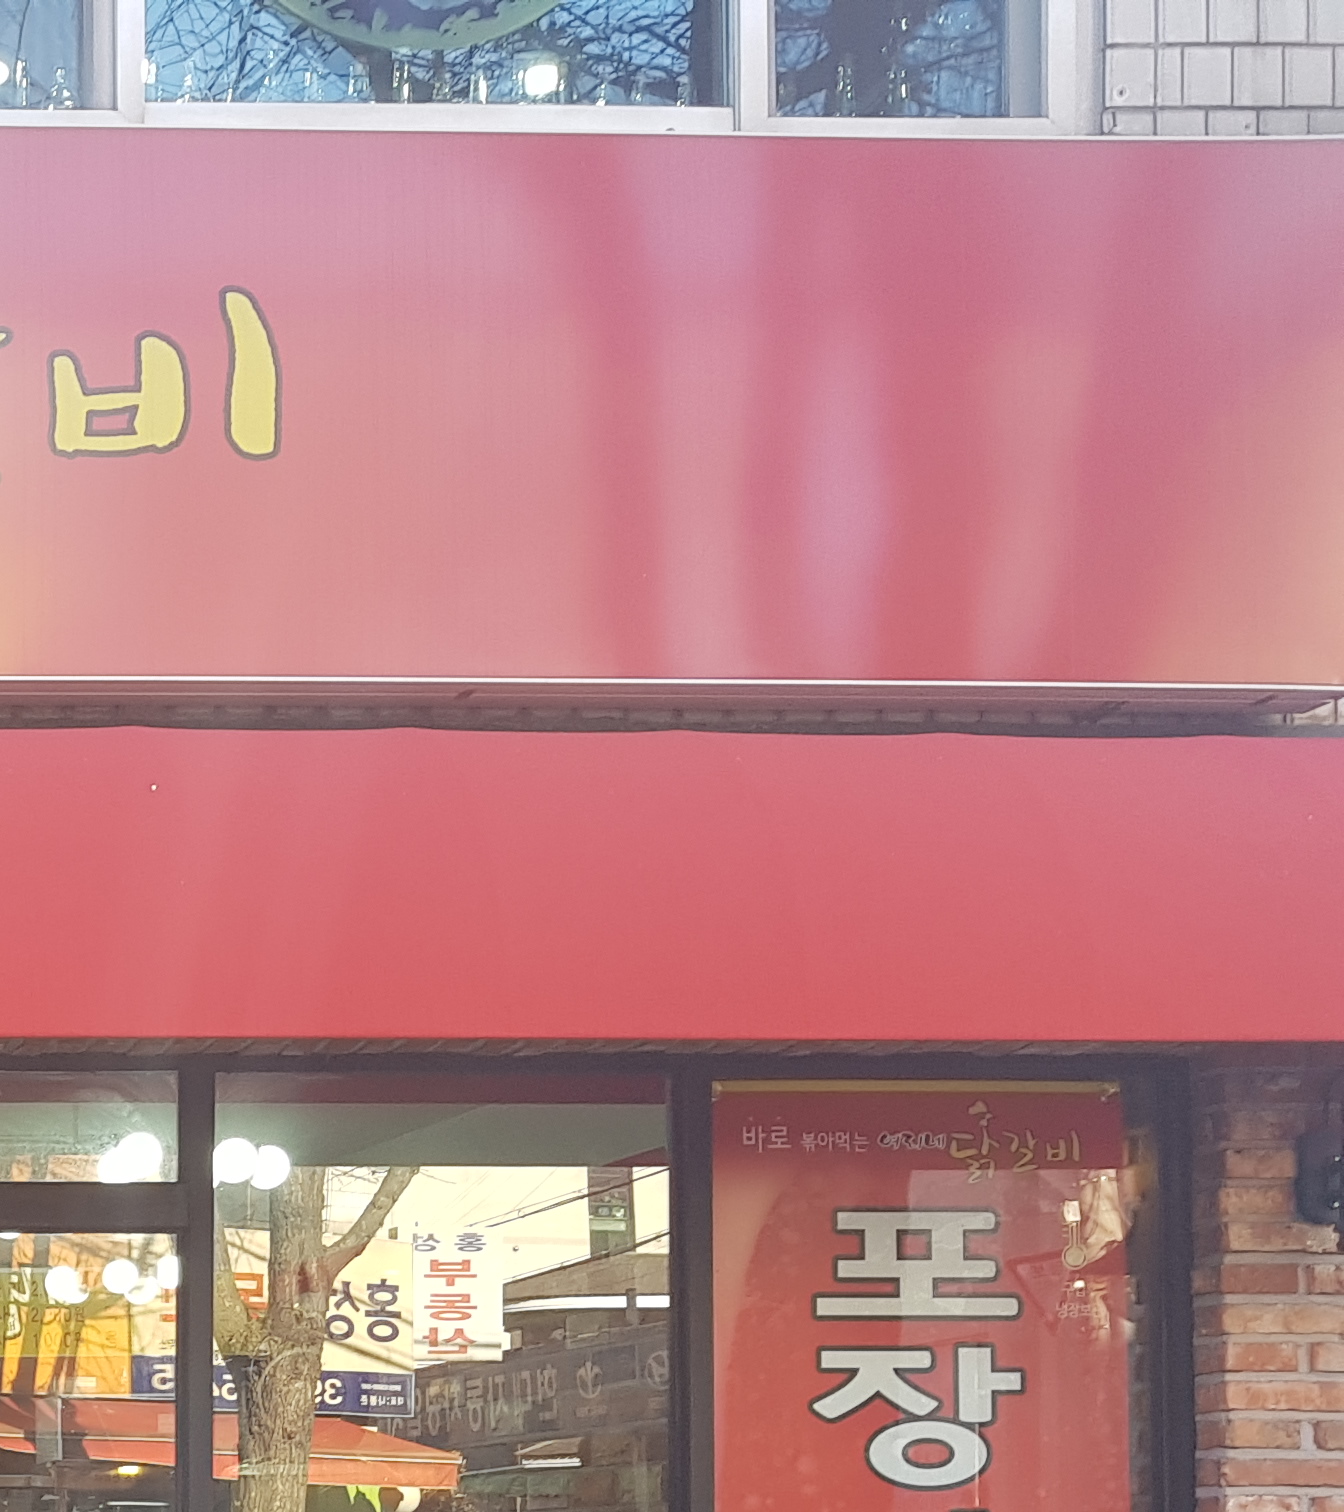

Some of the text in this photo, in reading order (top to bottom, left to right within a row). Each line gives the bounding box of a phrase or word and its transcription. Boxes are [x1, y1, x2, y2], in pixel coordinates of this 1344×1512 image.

[741, 1125, 792, 1153] 바로
[800, 1131, 871, 1153] 볶아먹는
[949, 1124, 1081, 1185] 닭갈비
